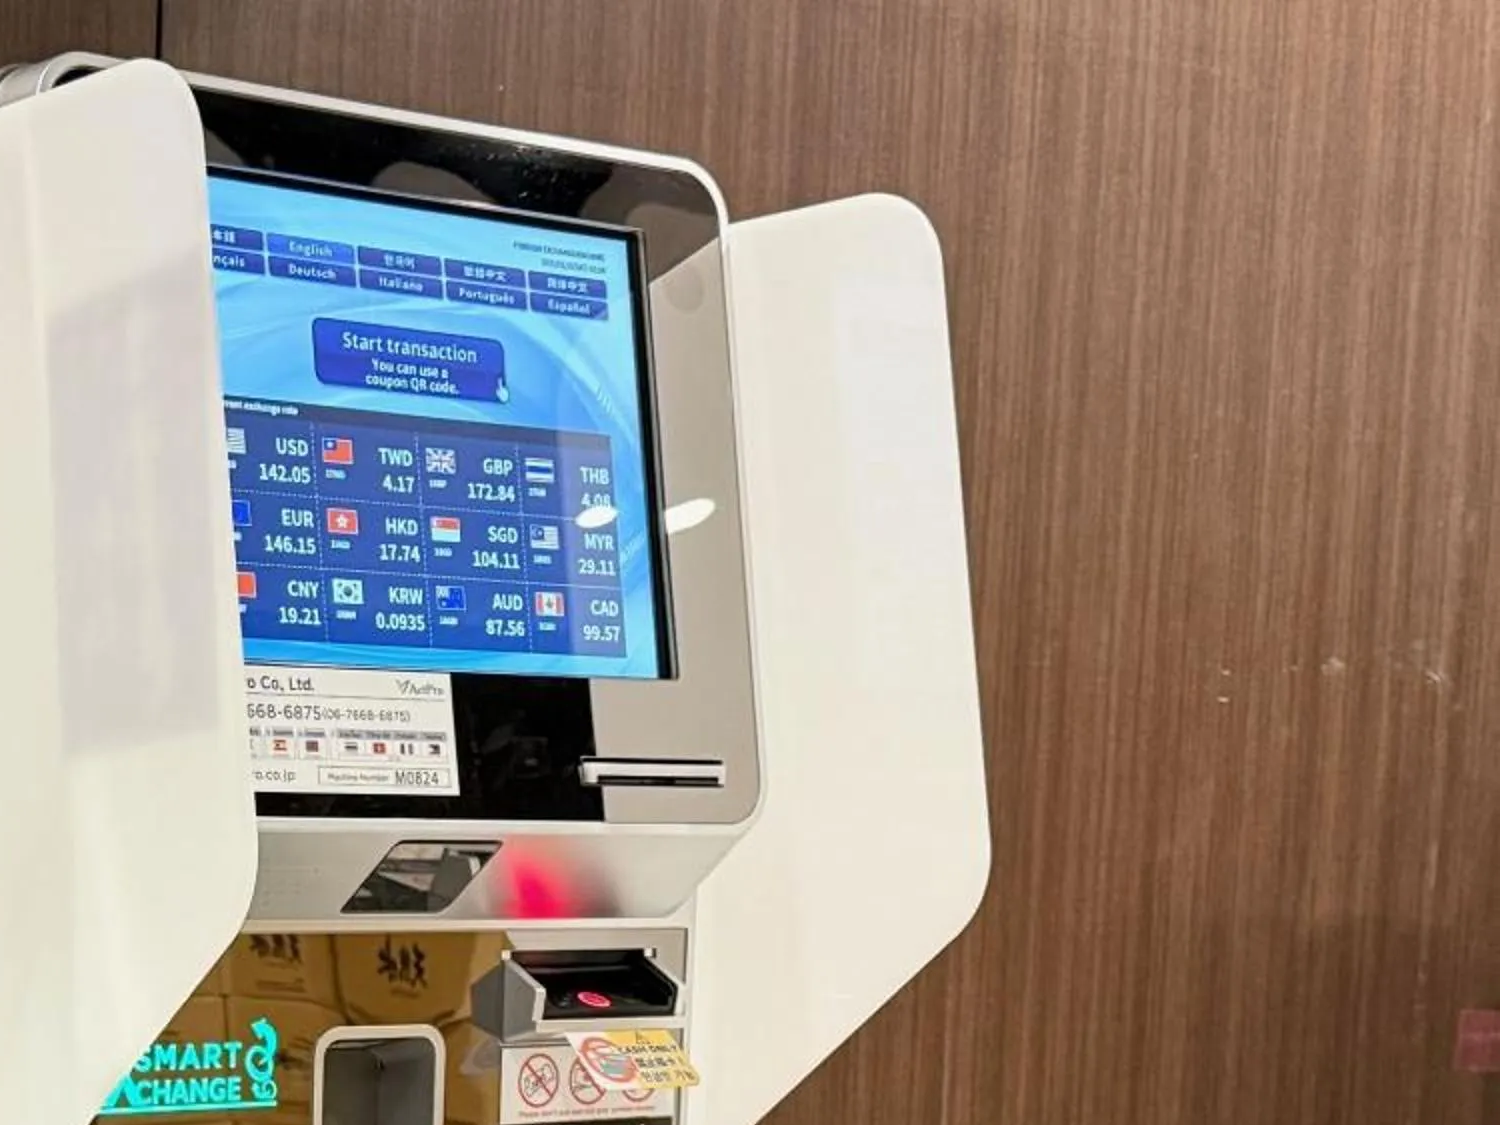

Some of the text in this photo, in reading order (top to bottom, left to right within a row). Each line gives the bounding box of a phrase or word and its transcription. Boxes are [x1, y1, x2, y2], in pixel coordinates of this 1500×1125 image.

[289, 240, 333, 257] English
[289, 264, 336, 279] Deutsch
[379, 276, 423, 293] Italiano
[547, 299, 590, 315] Español
[342, 331, 478, 363] Start transaction
[372, 358, 449, 379] You can use a
[365, 374, 460, 394] coupon QR code.
[276, 437, 308, 456] USD
[378, 447, 413, 467] TWD
[259, 463, 310, 483] 142.05
[484, 457, 512, 477] GBP
[581, 466, 609, 485] THB
[383, 473, 414, 492] 4.17
[467, 482, 516, 502] 172.84
[282, 510, 314, 528] EUR
[386, 519, 418, 536] HKD
[265, 534, 315, 554] 146.15
[488, 526, 517, 545] SGD
[585, 533, 613, 552] MYR
[380, 544, 420, 562] 17.74
[472, 551, 519, 570] 104.11
[579, 558, 615, 576] 29.11
[288, 581, 318, 599] CNY
[389, 587, 423, 605] KRW
[493, 594, 522, 612] AUD
[591, 599, 618, 617] CAD
[279, 606, 320, 625] 19.21
[376, 612, 425, 631] 0.0935
[486, 619, 524, 637] 87.56
[583, 624, 620, 642] 99.57
[289, 676, 315, 691] Ltd.
